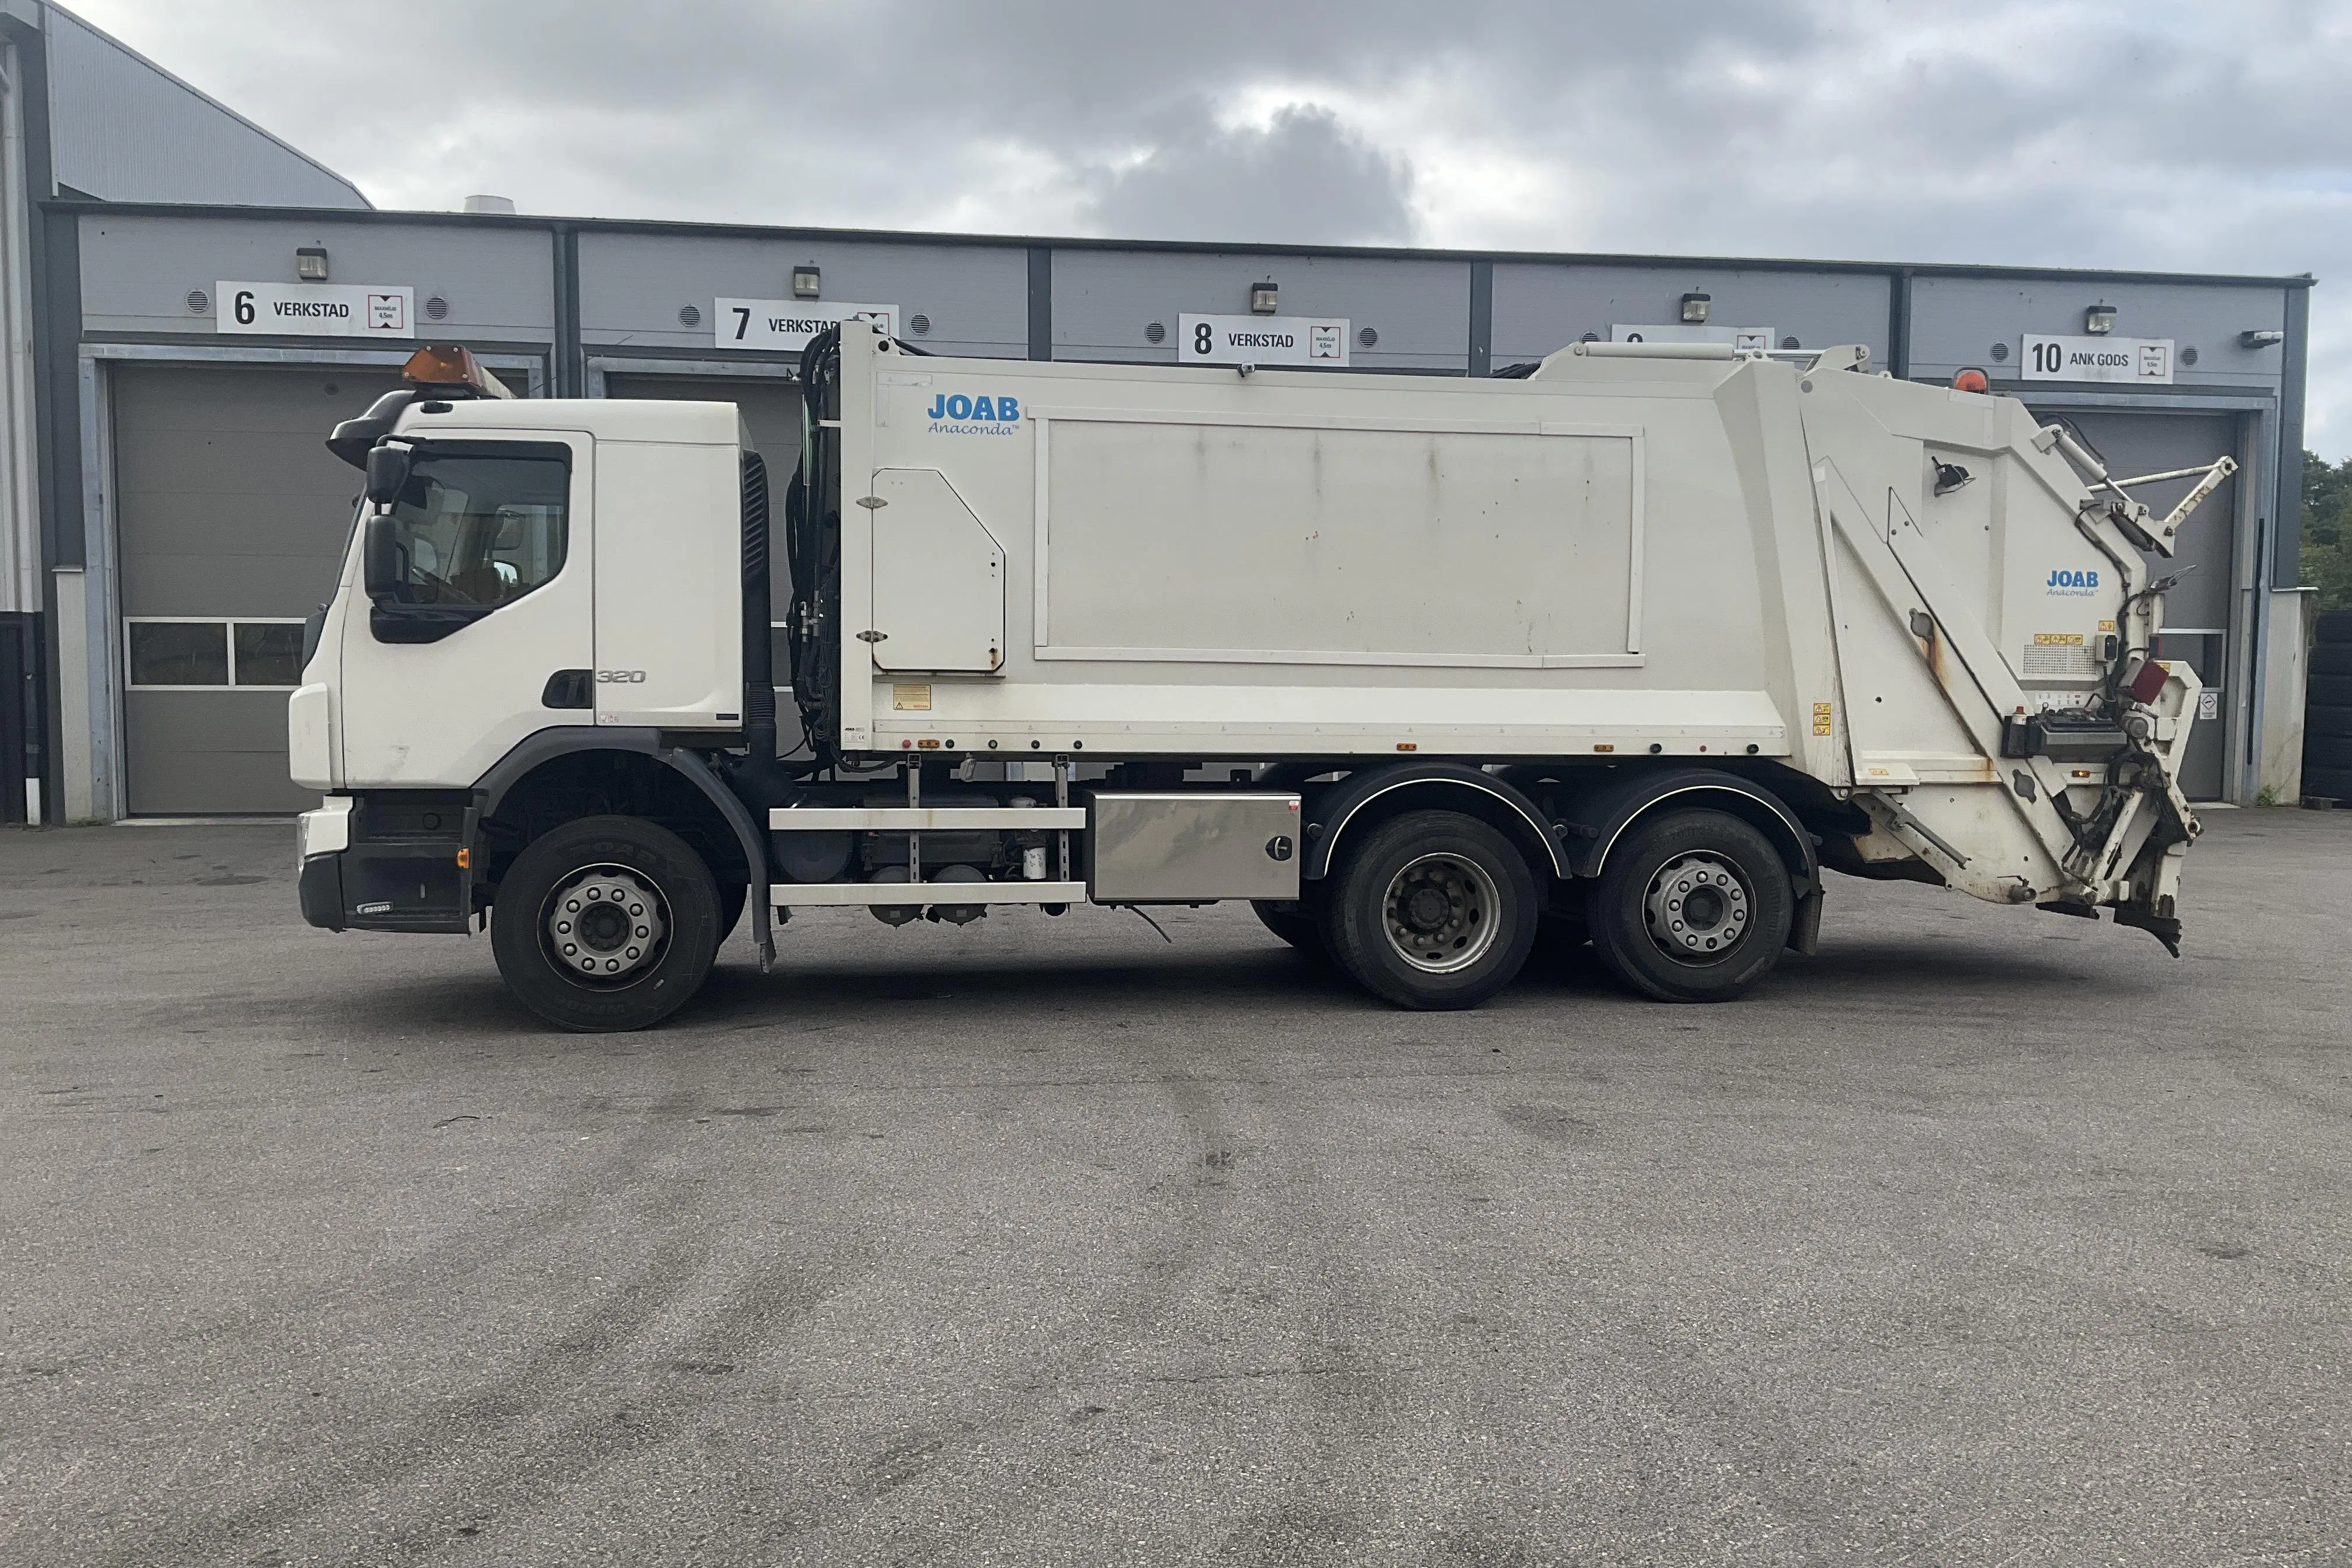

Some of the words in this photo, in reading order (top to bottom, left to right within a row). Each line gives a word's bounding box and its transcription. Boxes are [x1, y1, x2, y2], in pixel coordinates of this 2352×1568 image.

[235, 291, 255, 325] 6
[274, 302, 349, 317] VERKSTAD
[732, 308, 750, 340] 7
[1195, 323, 1212, 354] 8
[1228, 333, 1294, 348] VERKSTAD
[2032, 343, 2062, 373] 10
[2070, 353, 2095, 365] ANK
[2097, 354, 2129, 366] GODS
[928, 394, 1020, 421] JOAB
[2047, 570, 2099, 587] JOAB
[596, 670, 646, 682] 320
